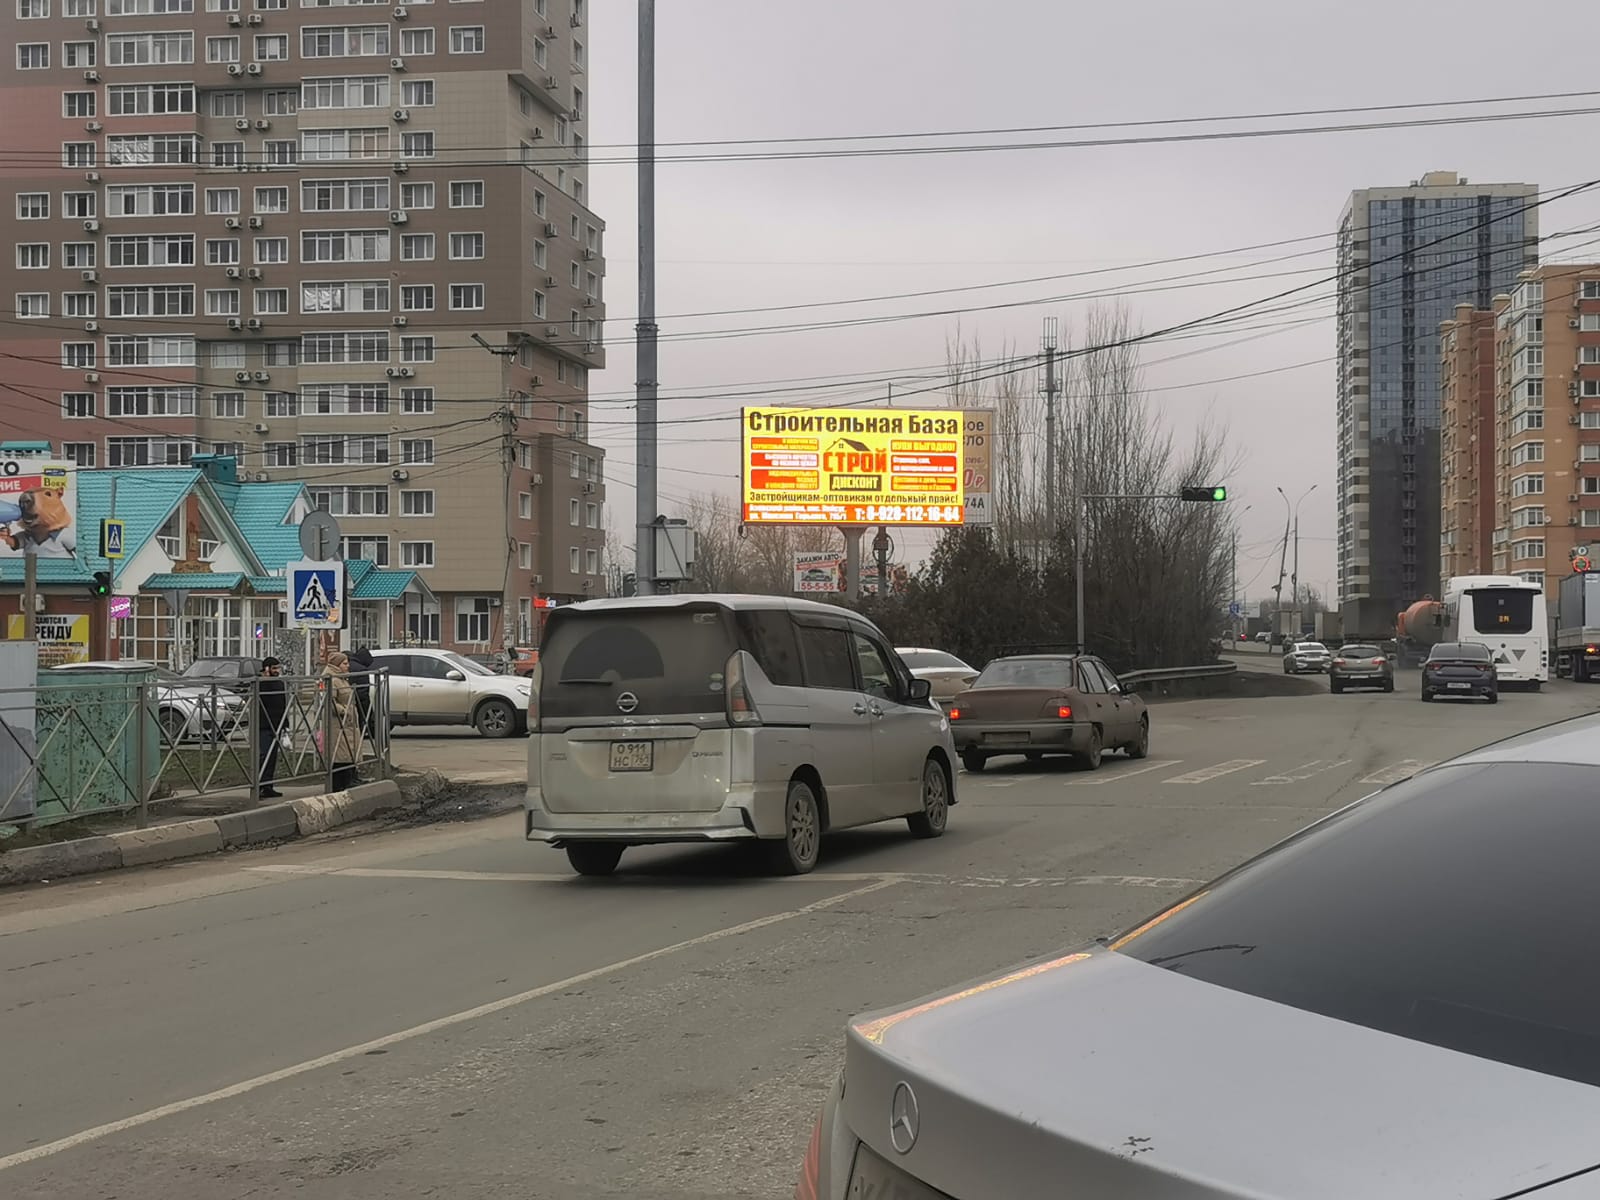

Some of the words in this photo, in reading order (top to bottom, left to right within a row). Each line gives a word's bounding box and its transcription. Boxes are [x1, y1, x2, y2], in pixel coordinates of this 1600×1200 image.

[749, 411, 903, 433] Строительная
[909, 415, 958, 434] База
[823, 448, 887, 473] СТРОЙ
[831, 476, 879, 490] ДИСКОНТ
[750, 491, 873, 504] Застройщикам-оптовикам
[875, 493, 927, 503] отдельный
[929, 494, 958, 504] прайс!
[801, 582, 834, 591] 55-5-55
[35, 616, 61, 625] ДАЮТСЯ
[35, 626, 72, 640] РЕНДУ
[627, 743, 646, 754] 911
[614, 756, 629, 767] НС
